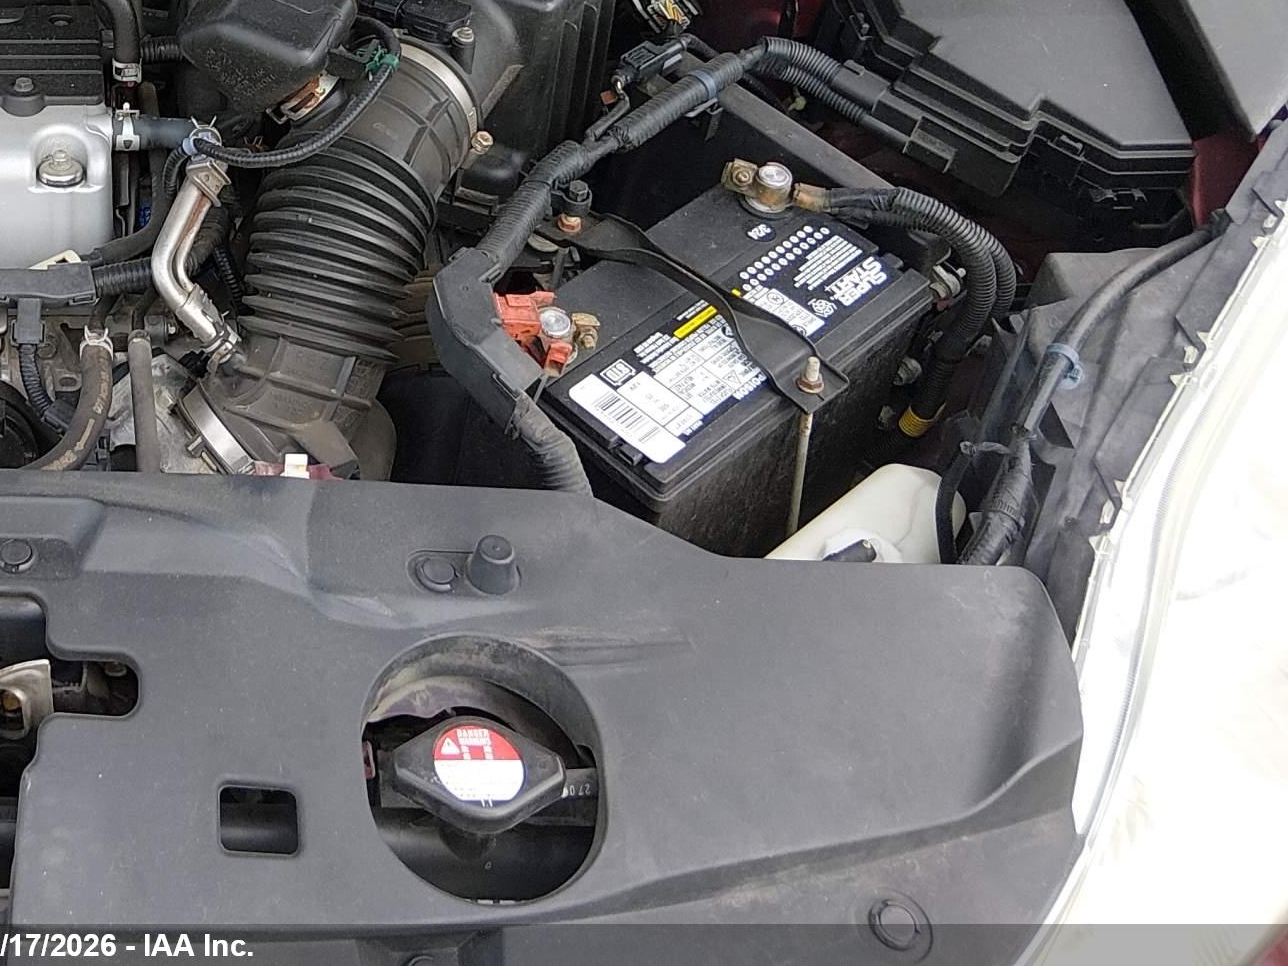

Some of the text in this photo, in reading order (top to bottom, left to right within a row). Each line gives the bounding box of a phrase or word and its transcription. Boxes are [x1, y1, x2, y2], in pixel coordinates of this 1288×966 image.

[747, 224, 772, 240] 3/24
[829, 256, 882, 295] START
[838, 271, 888, 307] SUPER
[731, 370, 768, 401] POISON
